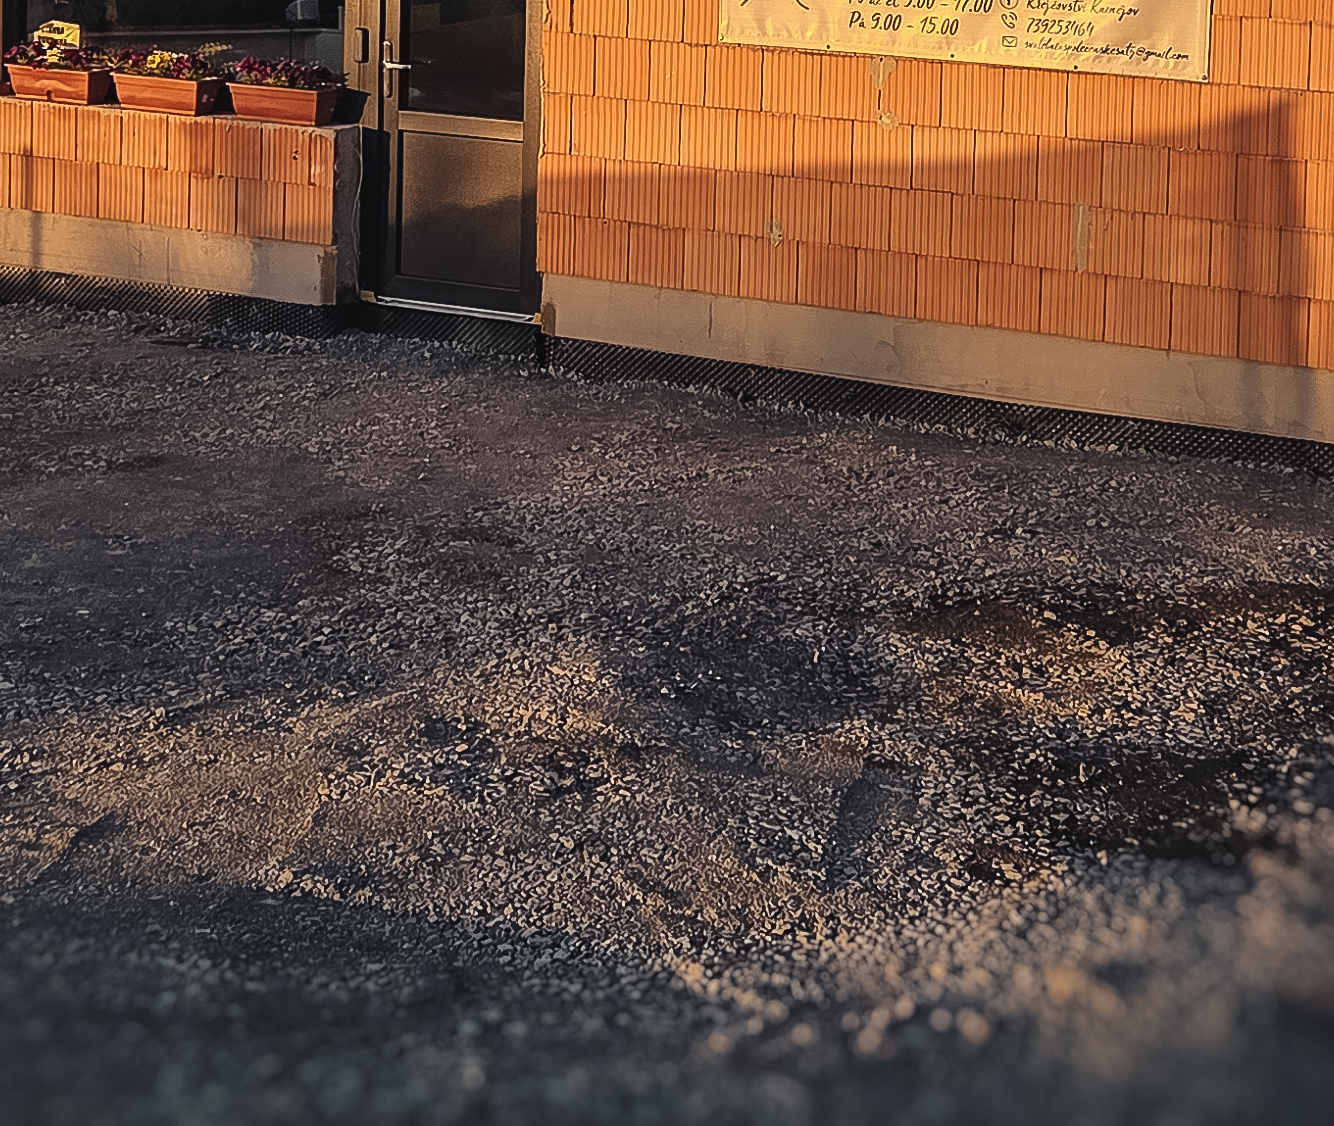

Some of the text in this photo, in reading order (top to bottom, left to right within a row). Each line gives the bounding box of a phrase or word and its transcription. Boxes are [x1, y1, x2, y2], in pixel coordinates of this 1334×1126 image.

[848, 10, 866, 29] Pá
[870, 12, 902, 32] 9.00
[919, 16, 959, 36] 15.00
